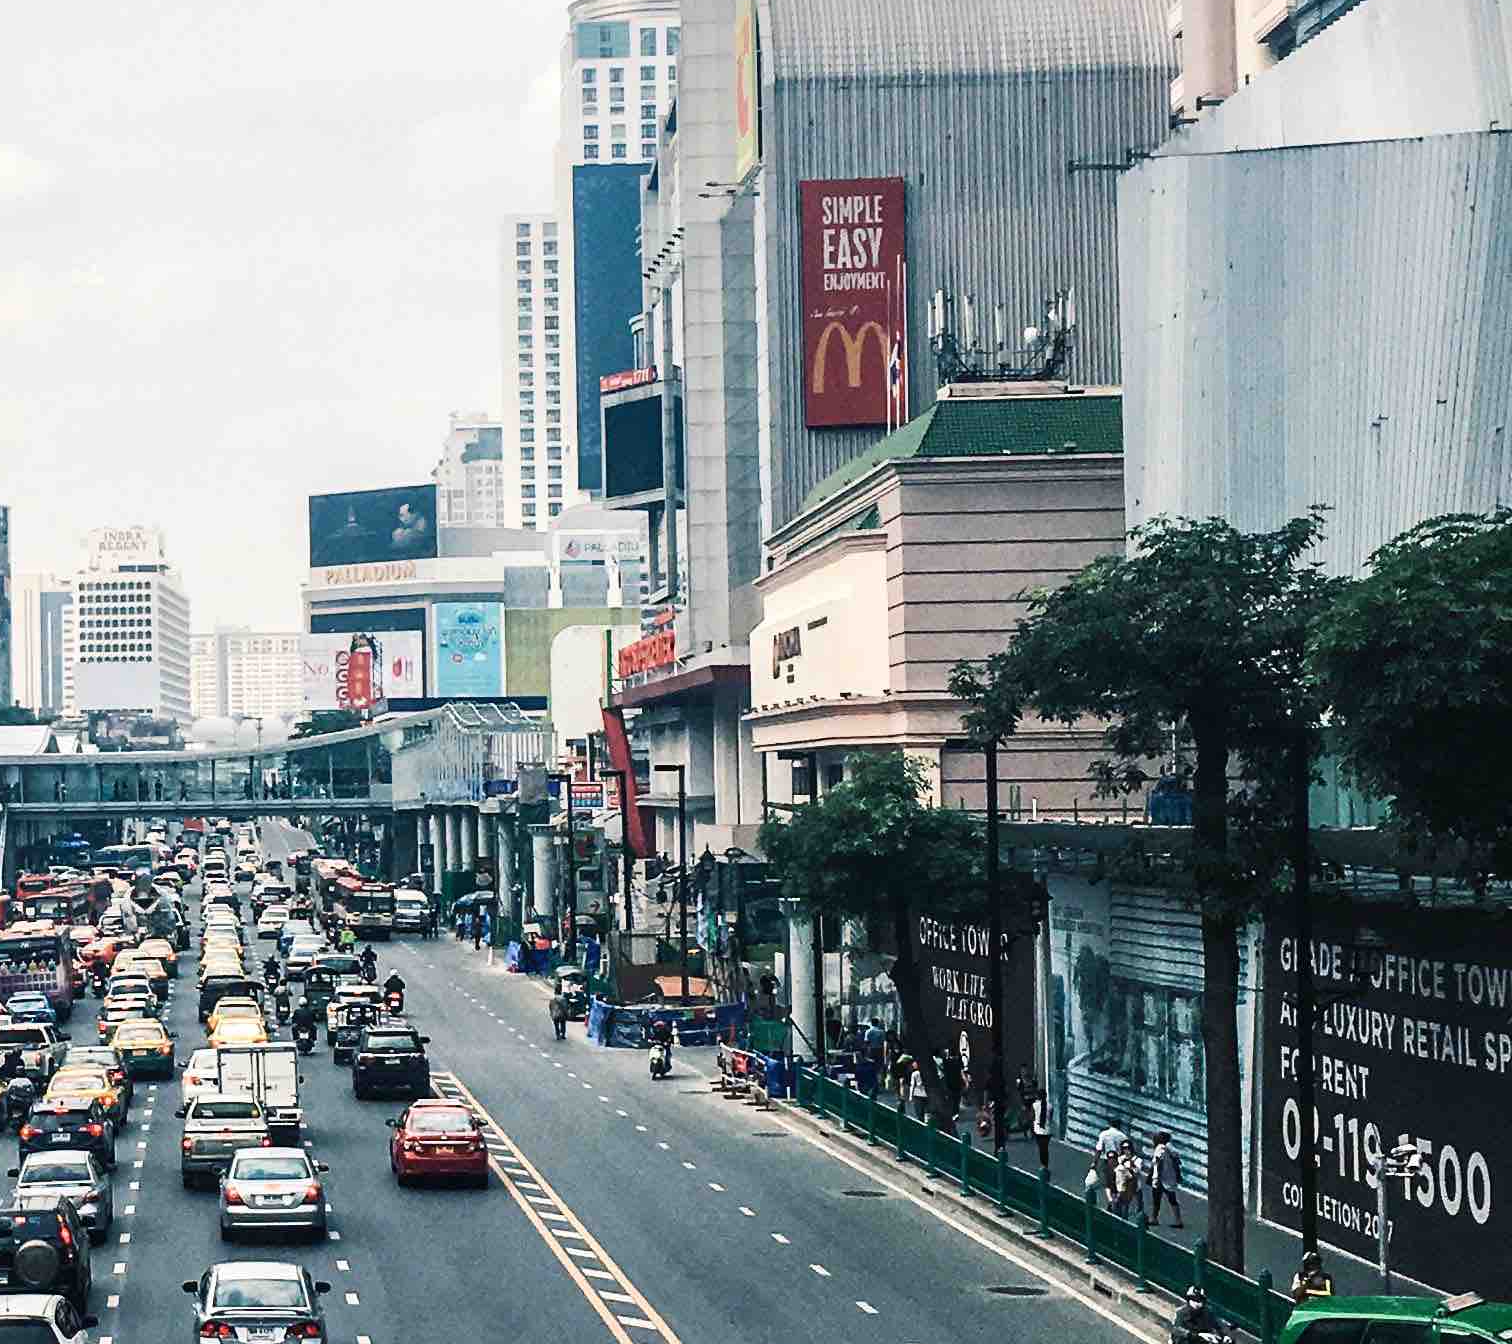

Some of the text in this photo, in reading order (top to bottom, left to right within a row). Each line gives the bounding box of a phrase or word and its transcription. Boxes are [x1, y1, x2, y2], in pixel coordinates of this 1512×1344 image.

[822, 194, 883, 225] SIMPLE
[823, 227, 883, 270] EASY
[824, 271, 886, 292] ENJOYMENT
[327, 560, 416, 584] PALLADIUM
[920, 917, 1009, 961] OFFICE TOWR
[1455, 963, 1512, 1007] TOW
[1324, 1002, 1395, 1050] LUXURY
[1403, 1019, 1477, 1068] RETAIL
[1485, 1032, 1512, 1072] SP
[1322, 1057, 1369, 1099] RENT
